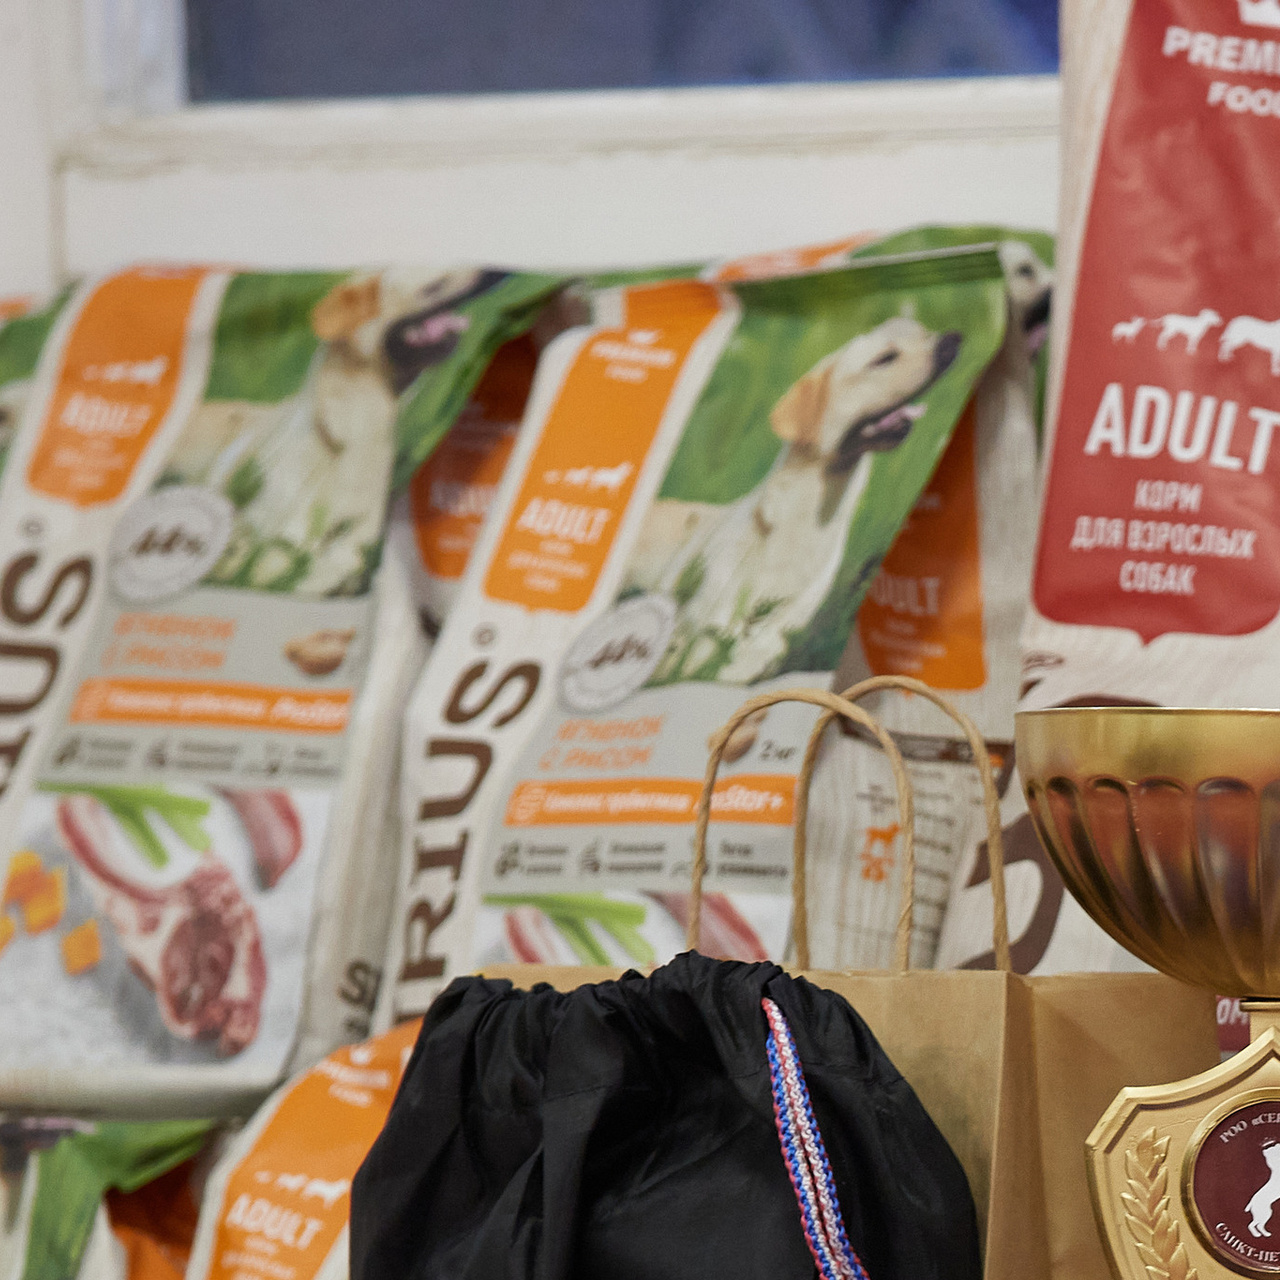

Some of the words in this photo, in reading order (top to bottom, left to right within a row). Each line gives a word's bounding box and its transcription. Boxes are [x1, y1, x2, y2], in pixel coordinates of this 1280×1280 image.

[1135, 479, 1202, 512] КОРМ
[1070, 516, 1125, 551] ДЛЯ
[1128, 520, 1257, 559] ВЗРОСЛЫХ
[1119, 560, 1195, 595] СОБАК
[1220, 1120, 1249, 1145] РОО
